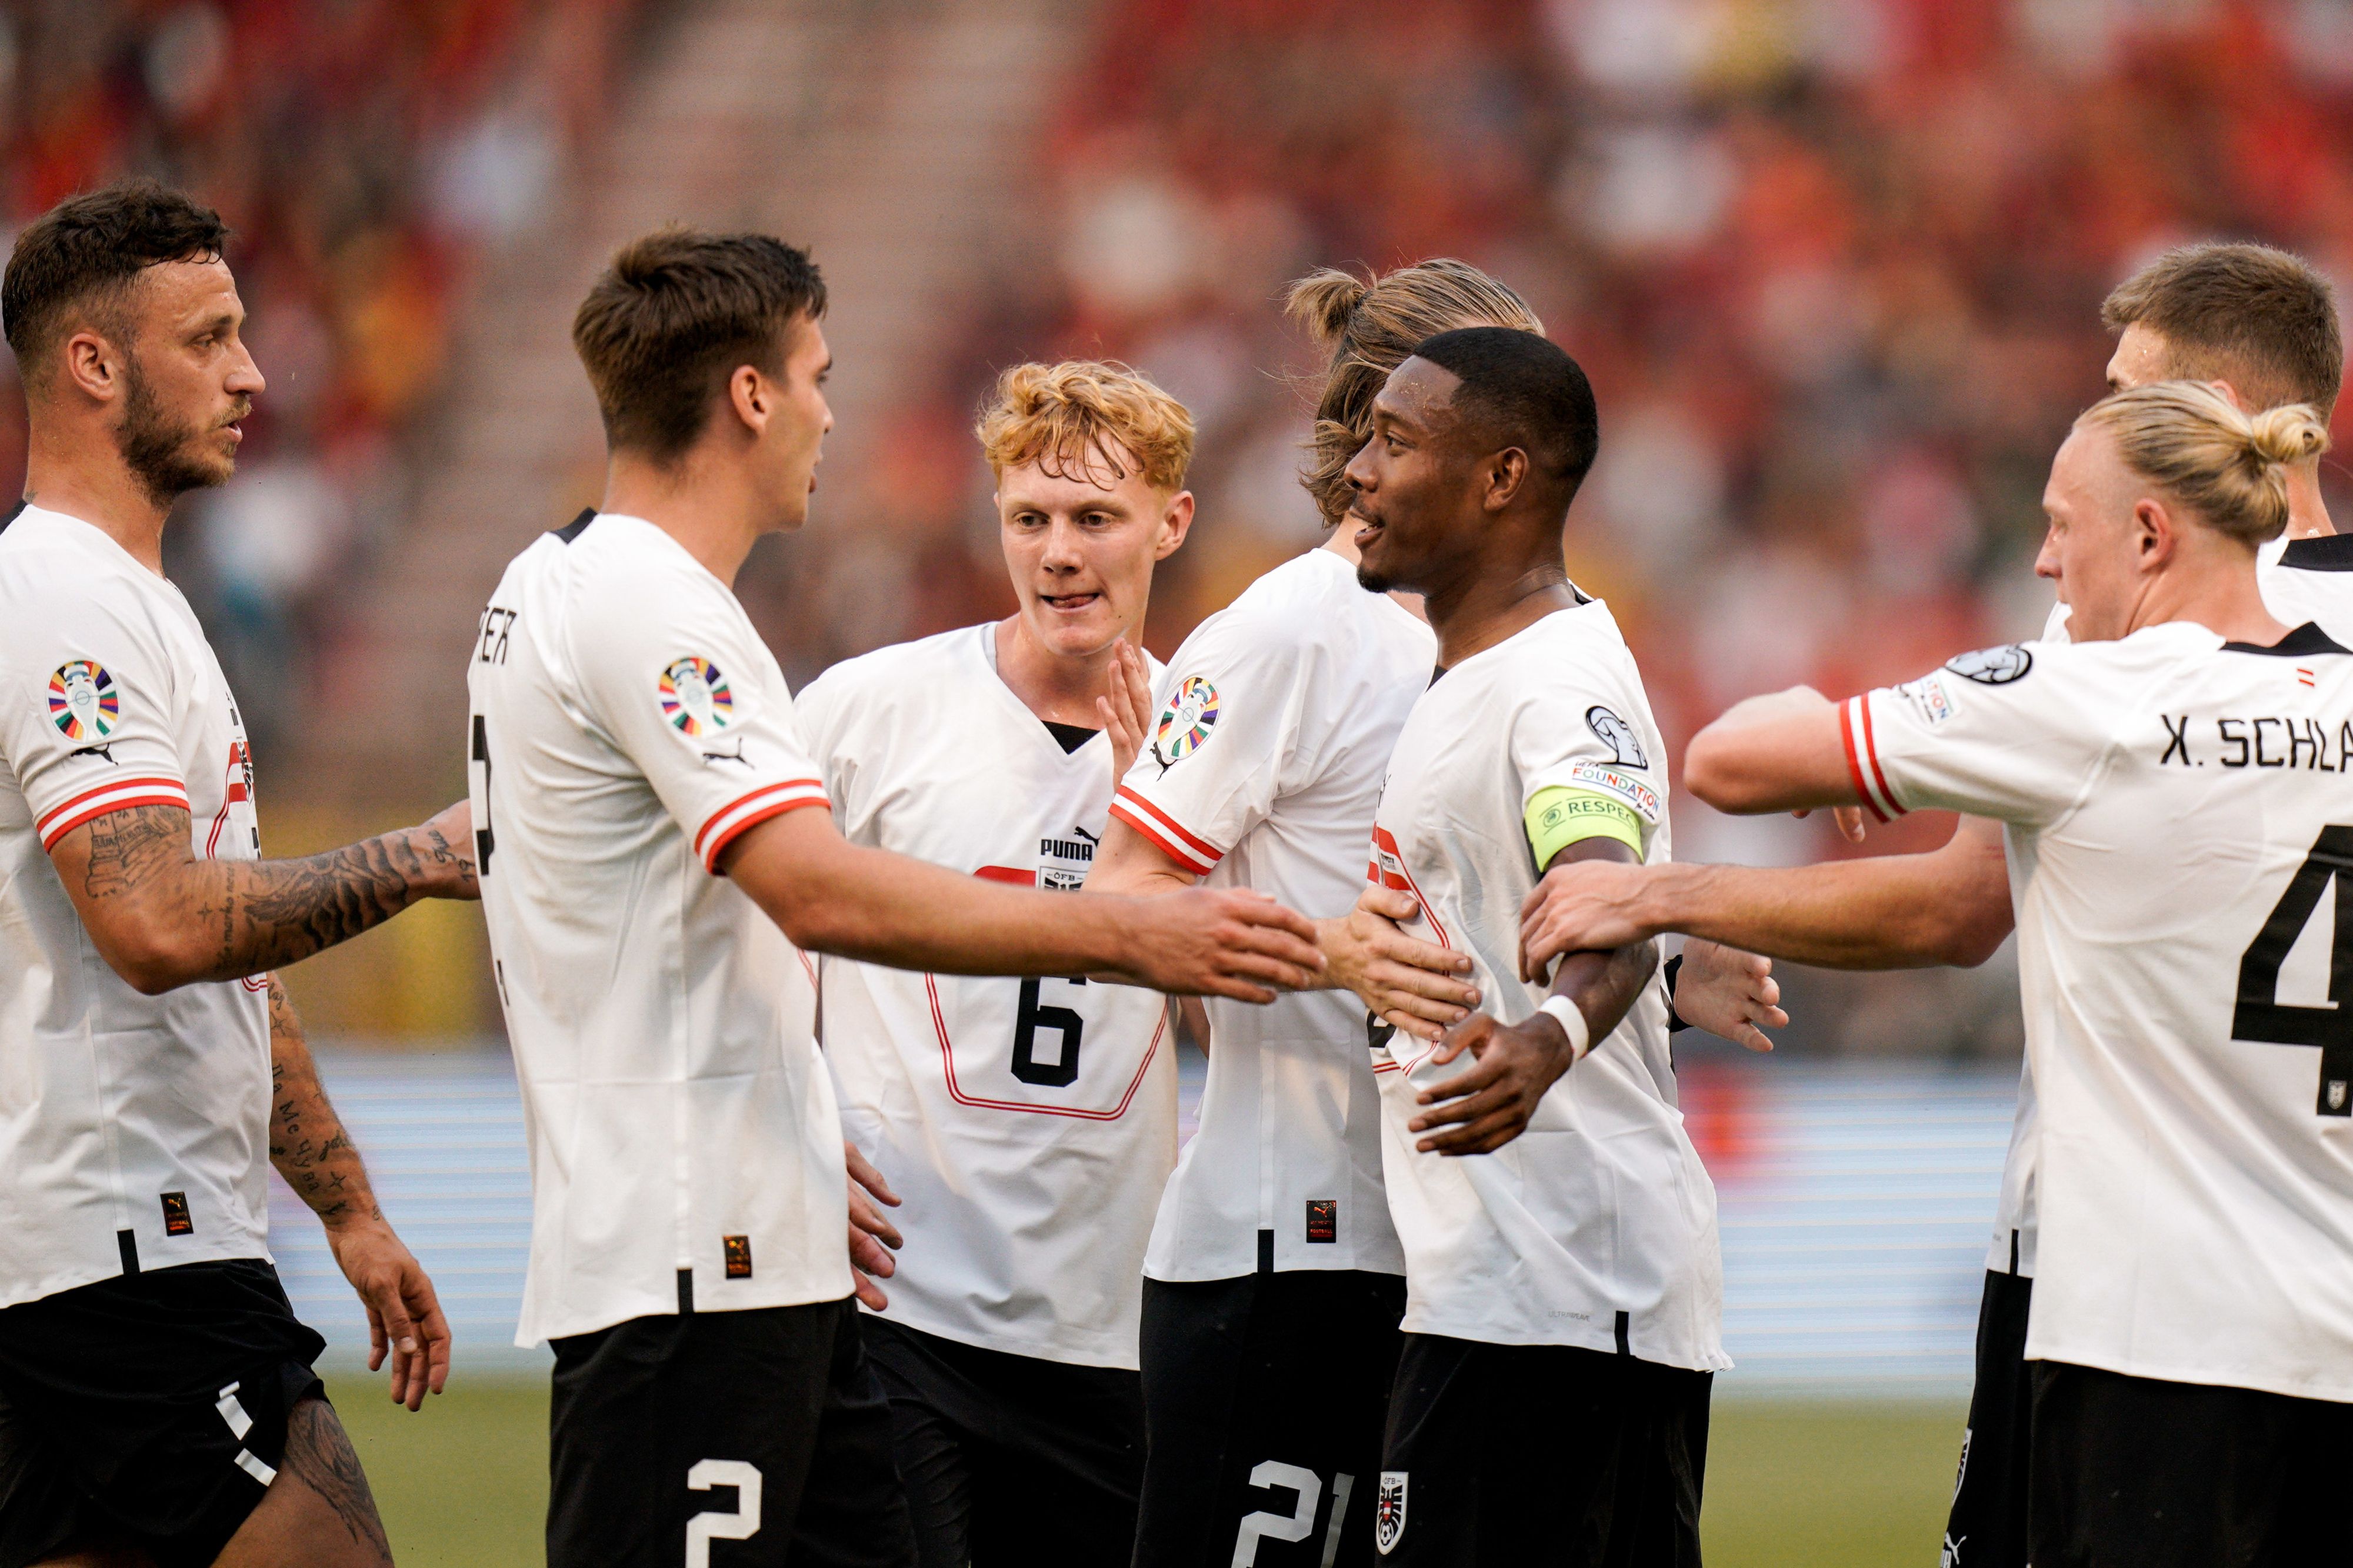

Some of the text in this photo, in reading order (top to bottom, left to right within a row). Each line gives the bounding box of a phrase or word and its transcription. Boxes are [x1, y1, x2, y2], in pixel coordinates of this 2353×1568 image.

[479, 607, 516, 665] ER
[2160, 714, 2204, 766] X.
[1572, 767, 1659, 813] FOUNDATION
[1041, 839, 1092, 861] PUMA
[2231, 825, 2353, 1117] 4
[1011, 975, 1087, 1088] 6
[685, 1458, 763, 1568] 2
